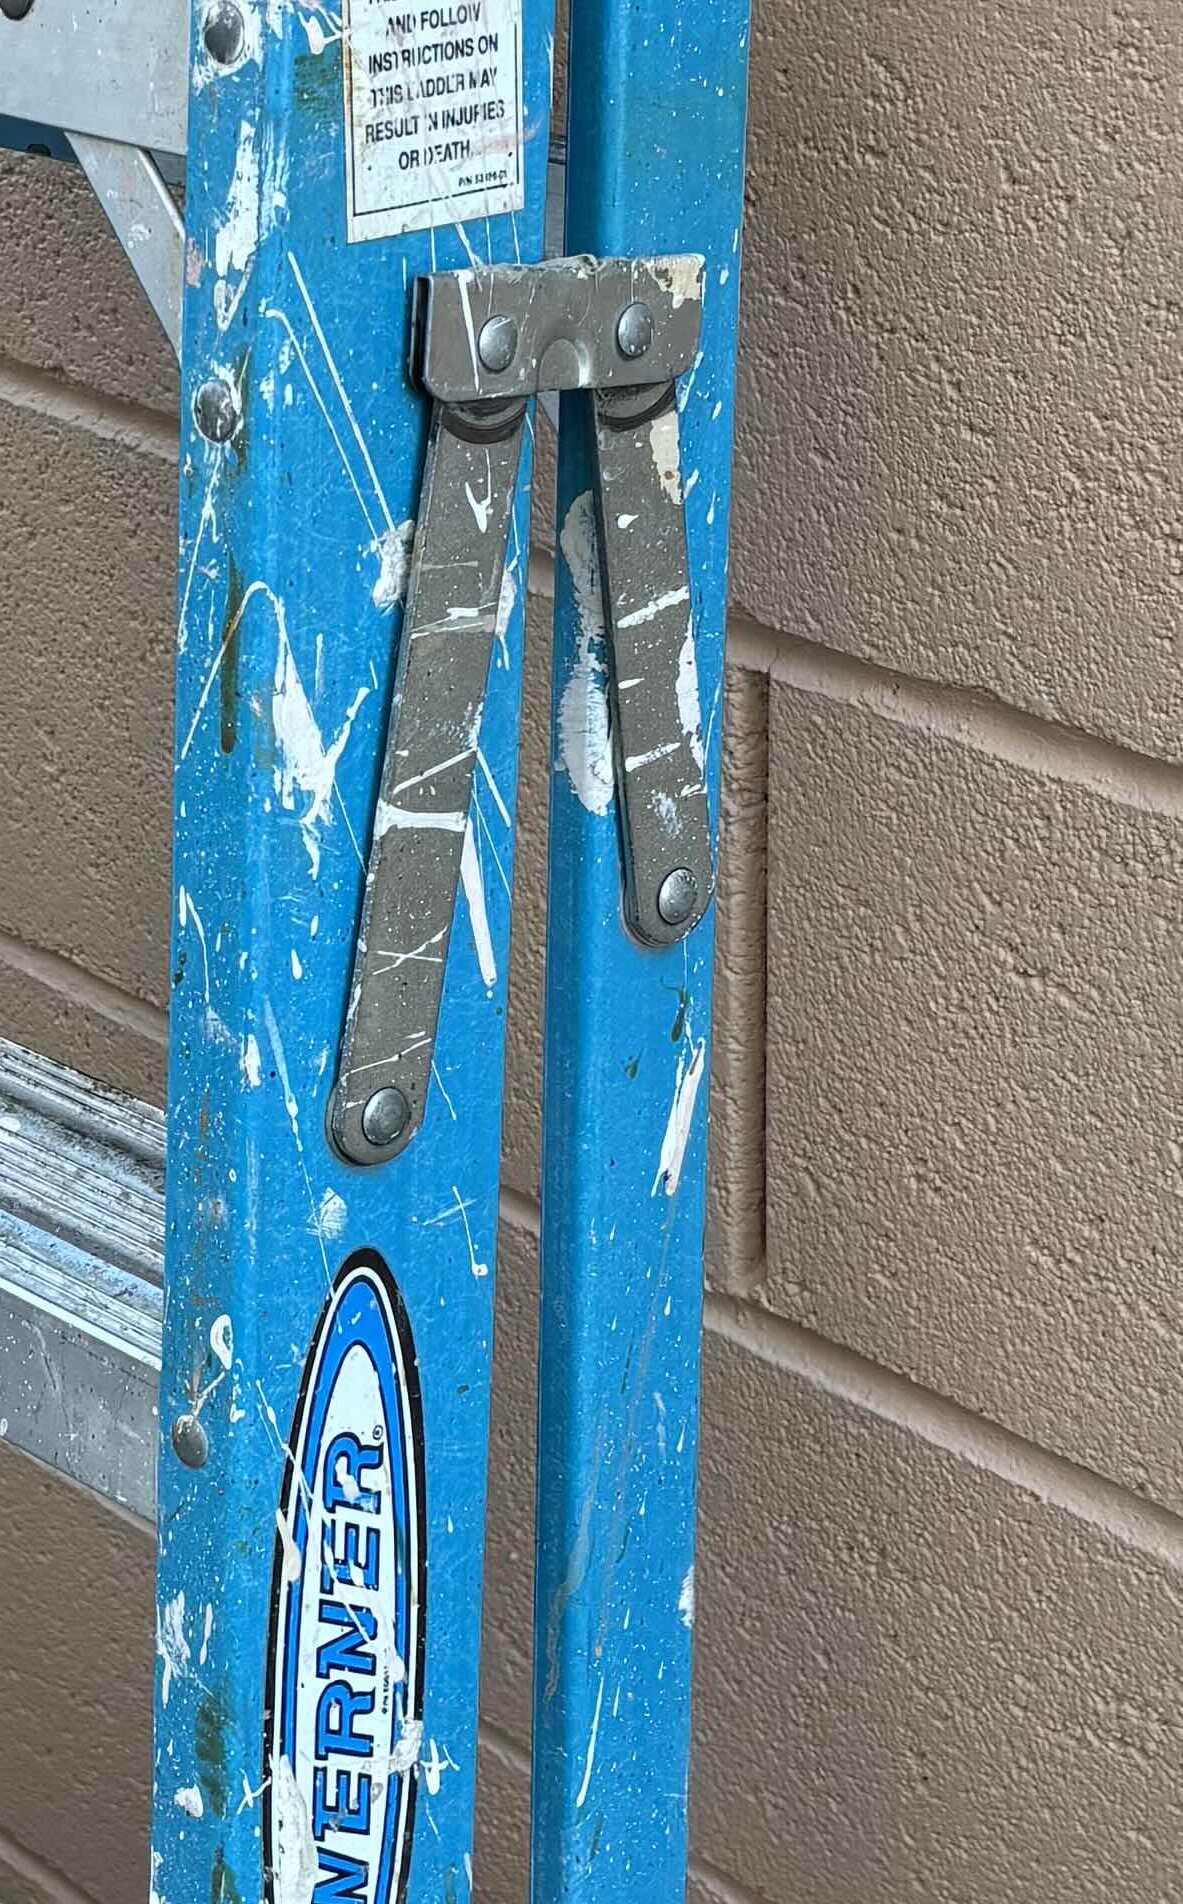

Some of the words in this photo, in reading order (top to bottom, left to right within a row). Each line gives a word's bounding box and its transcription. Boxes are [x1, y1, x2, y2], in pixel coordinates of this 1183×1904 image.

[420, 3, 481, 33] FOLLOW
[368, 36, 475, 75] INSTRUCTIONS
[477, 32, 499, 56] ON
[364, 115, 419, 145] RESULT
[441, 99, 506, 129] INJURIES
[397, 149, 419, 171] OR
